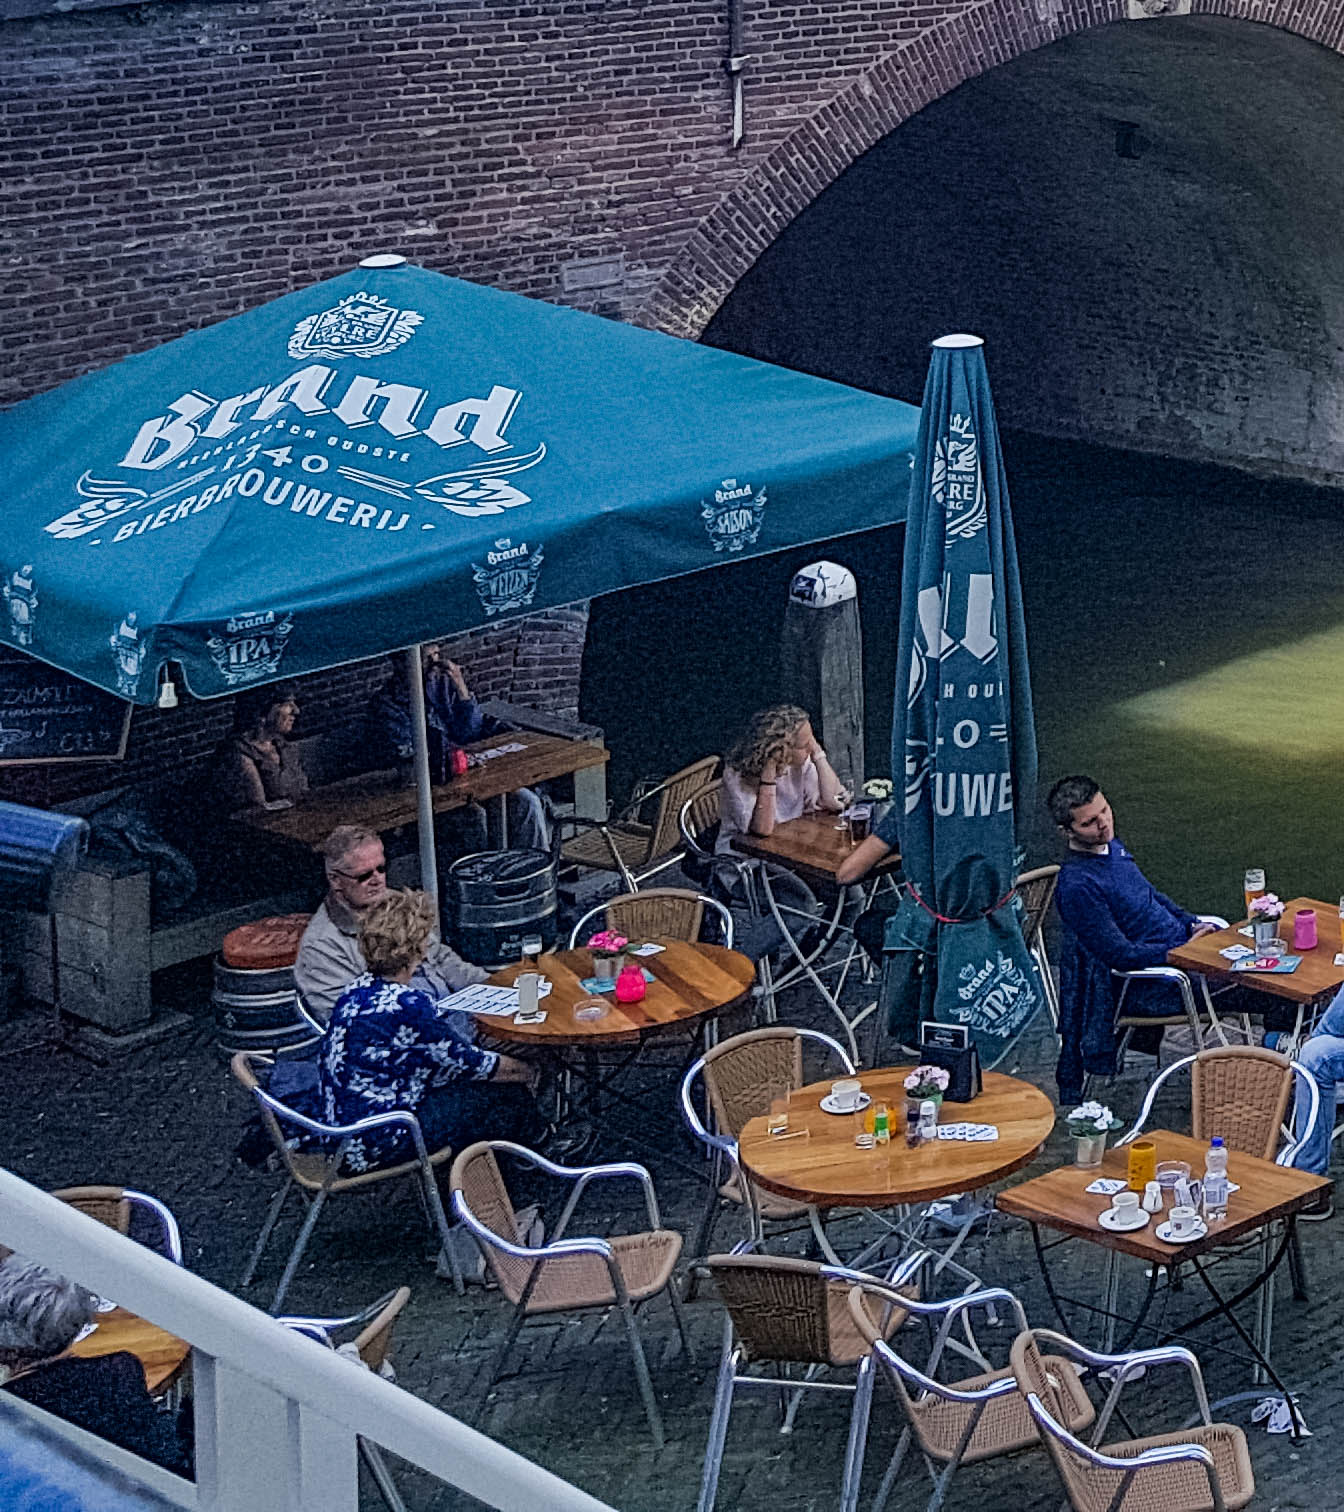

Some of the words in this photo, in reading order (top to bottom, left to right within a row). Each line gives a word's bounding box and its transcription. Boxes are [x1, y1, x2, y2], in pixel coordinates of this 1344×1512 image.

[118, 364, 522, 472] Brand
[221, 443, 329, 473] 1340
[327, 436, 411, 462] OUDSTE
[112, 467, 411, 543] BIERBROUWERIJ
[715, 484, 753, 503] Brand
[716, 509, 754, 534] SAISON
[487, 543, 529, 565] Brand
[226, 610, 276, 633] Brand
[229, 637, 271, 664] IPA
[957, 958, 996, 1001] Brand
[982, 981, 1020, 1021] IPA
